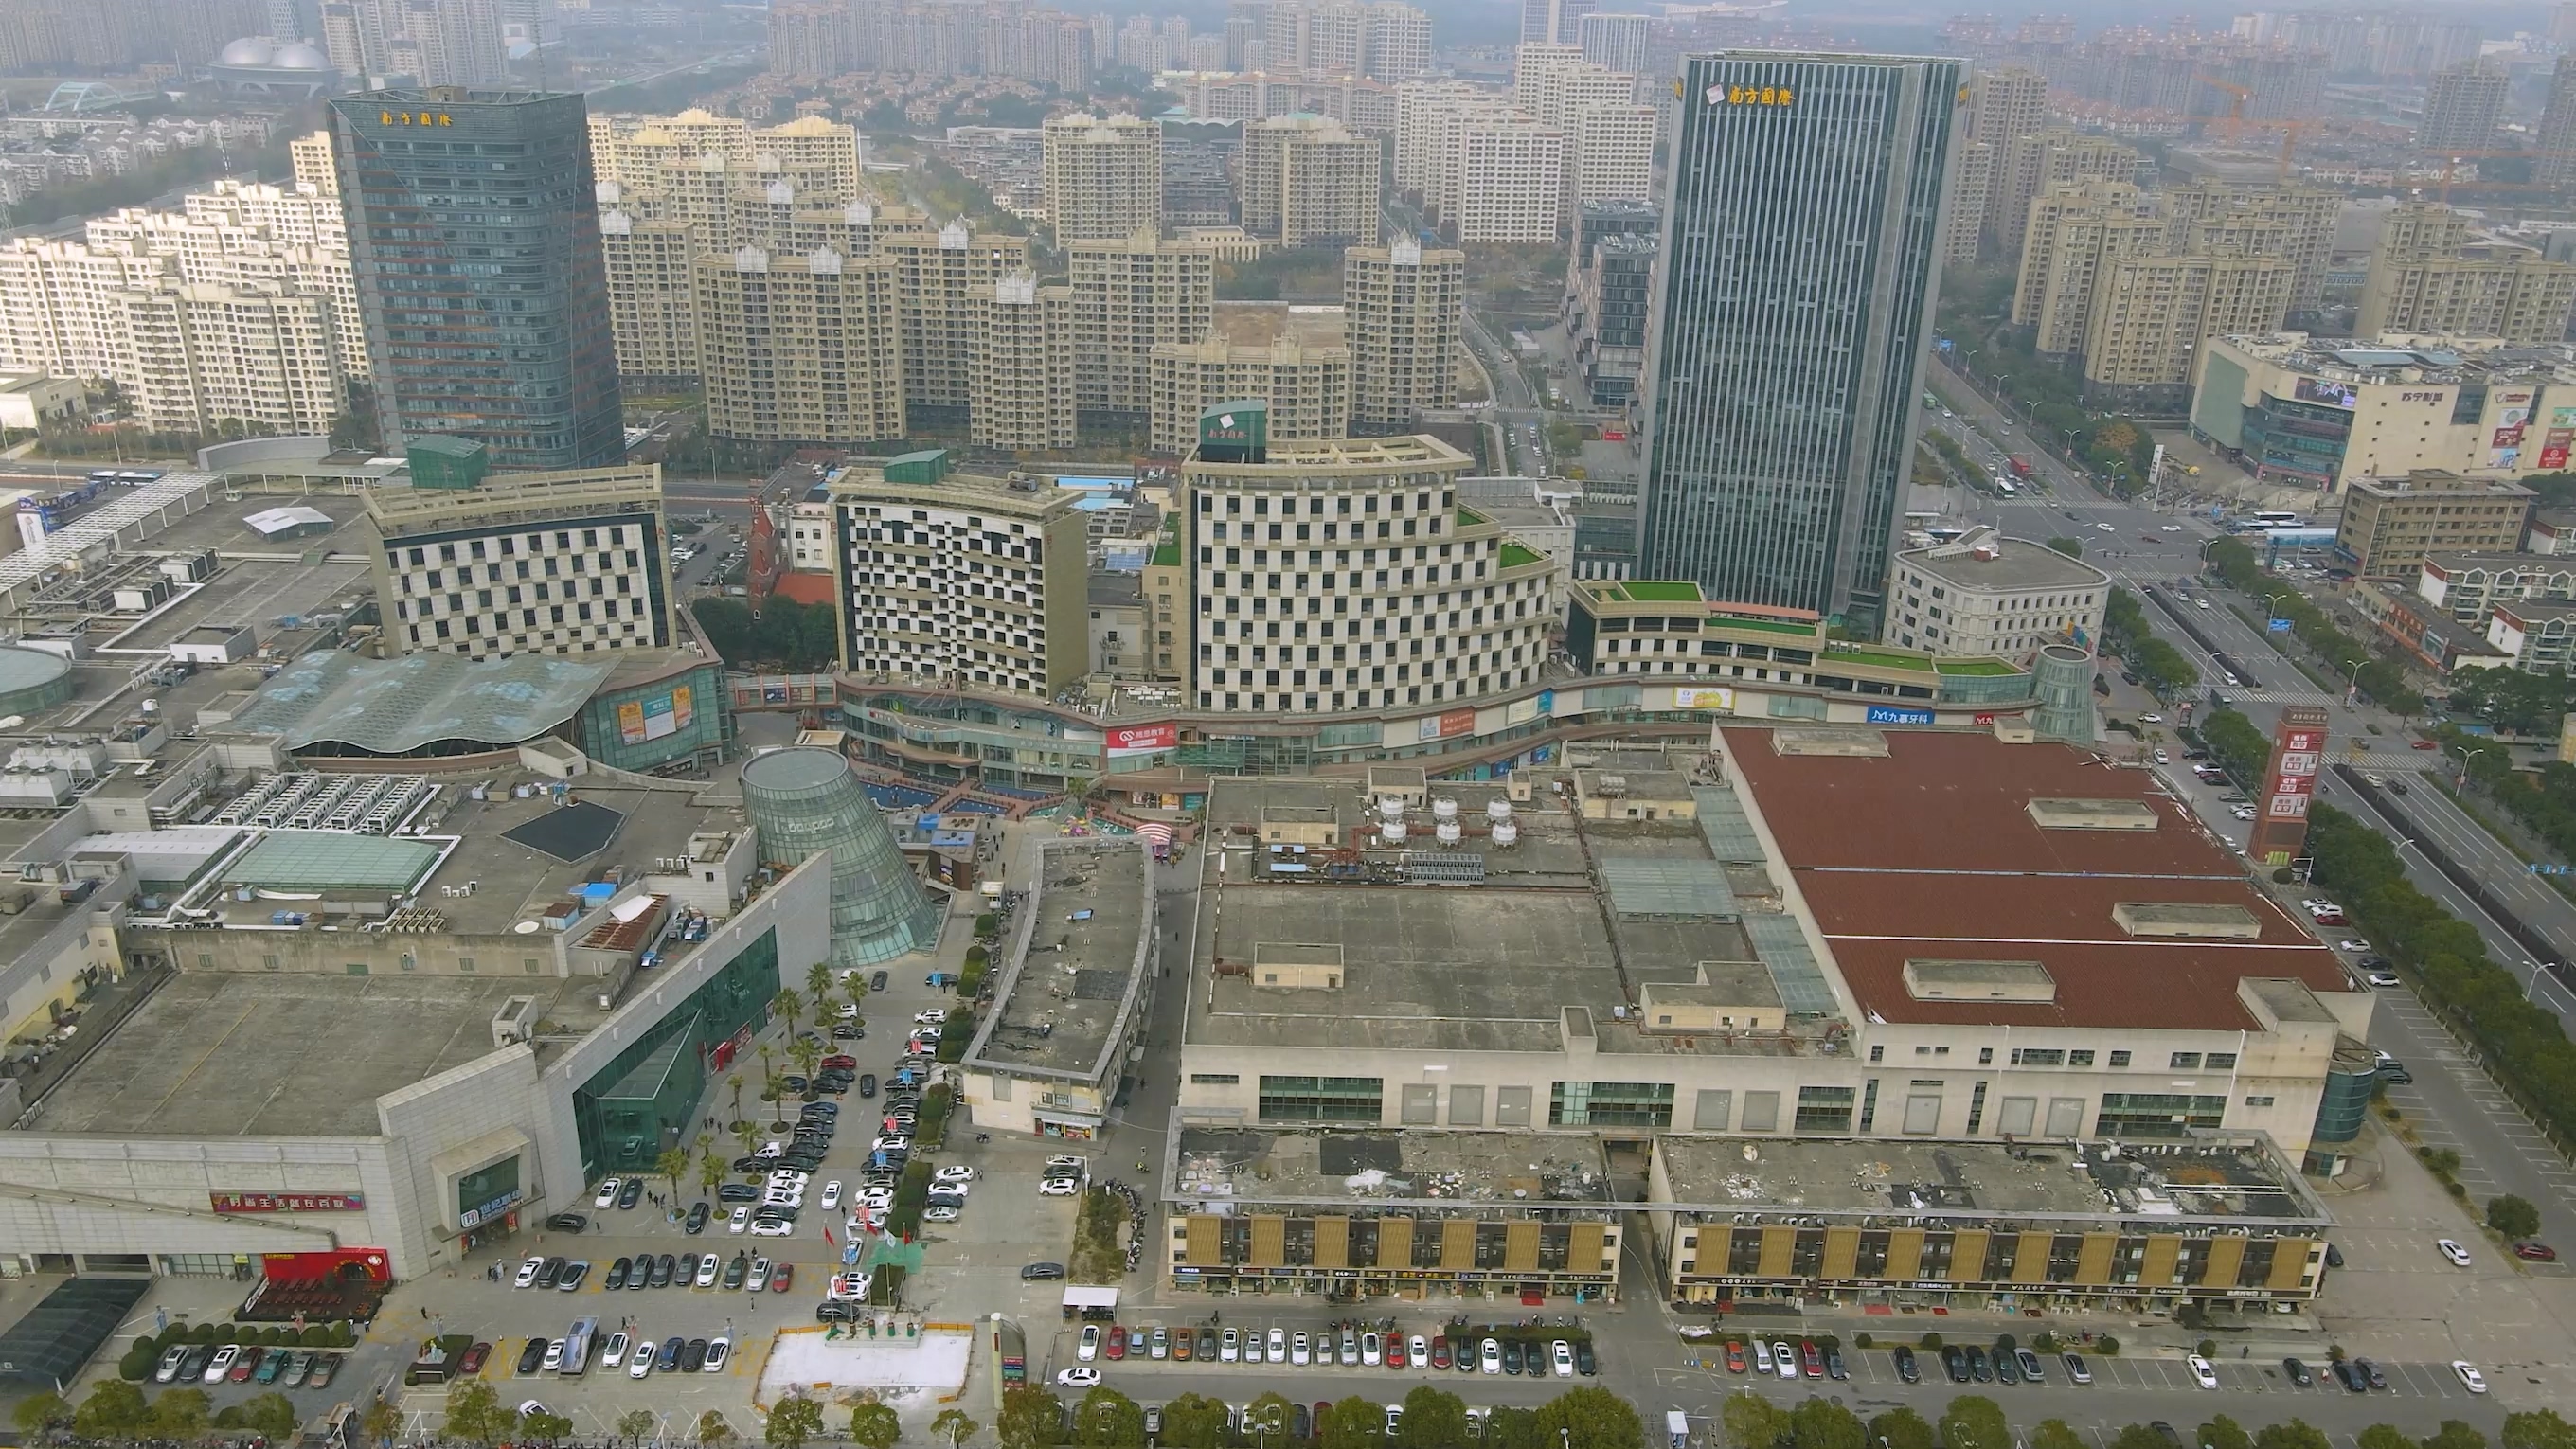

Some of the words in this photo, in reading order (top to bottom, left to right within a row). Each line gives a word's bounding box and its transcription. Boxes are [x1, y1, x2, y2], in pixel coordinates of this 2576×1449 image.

[1728, 86, 1796, 106] 南方國際
[381, 111, 454, 128] 南方國際
[230, 1197, 346, 1209] 时尚生活就在百联
